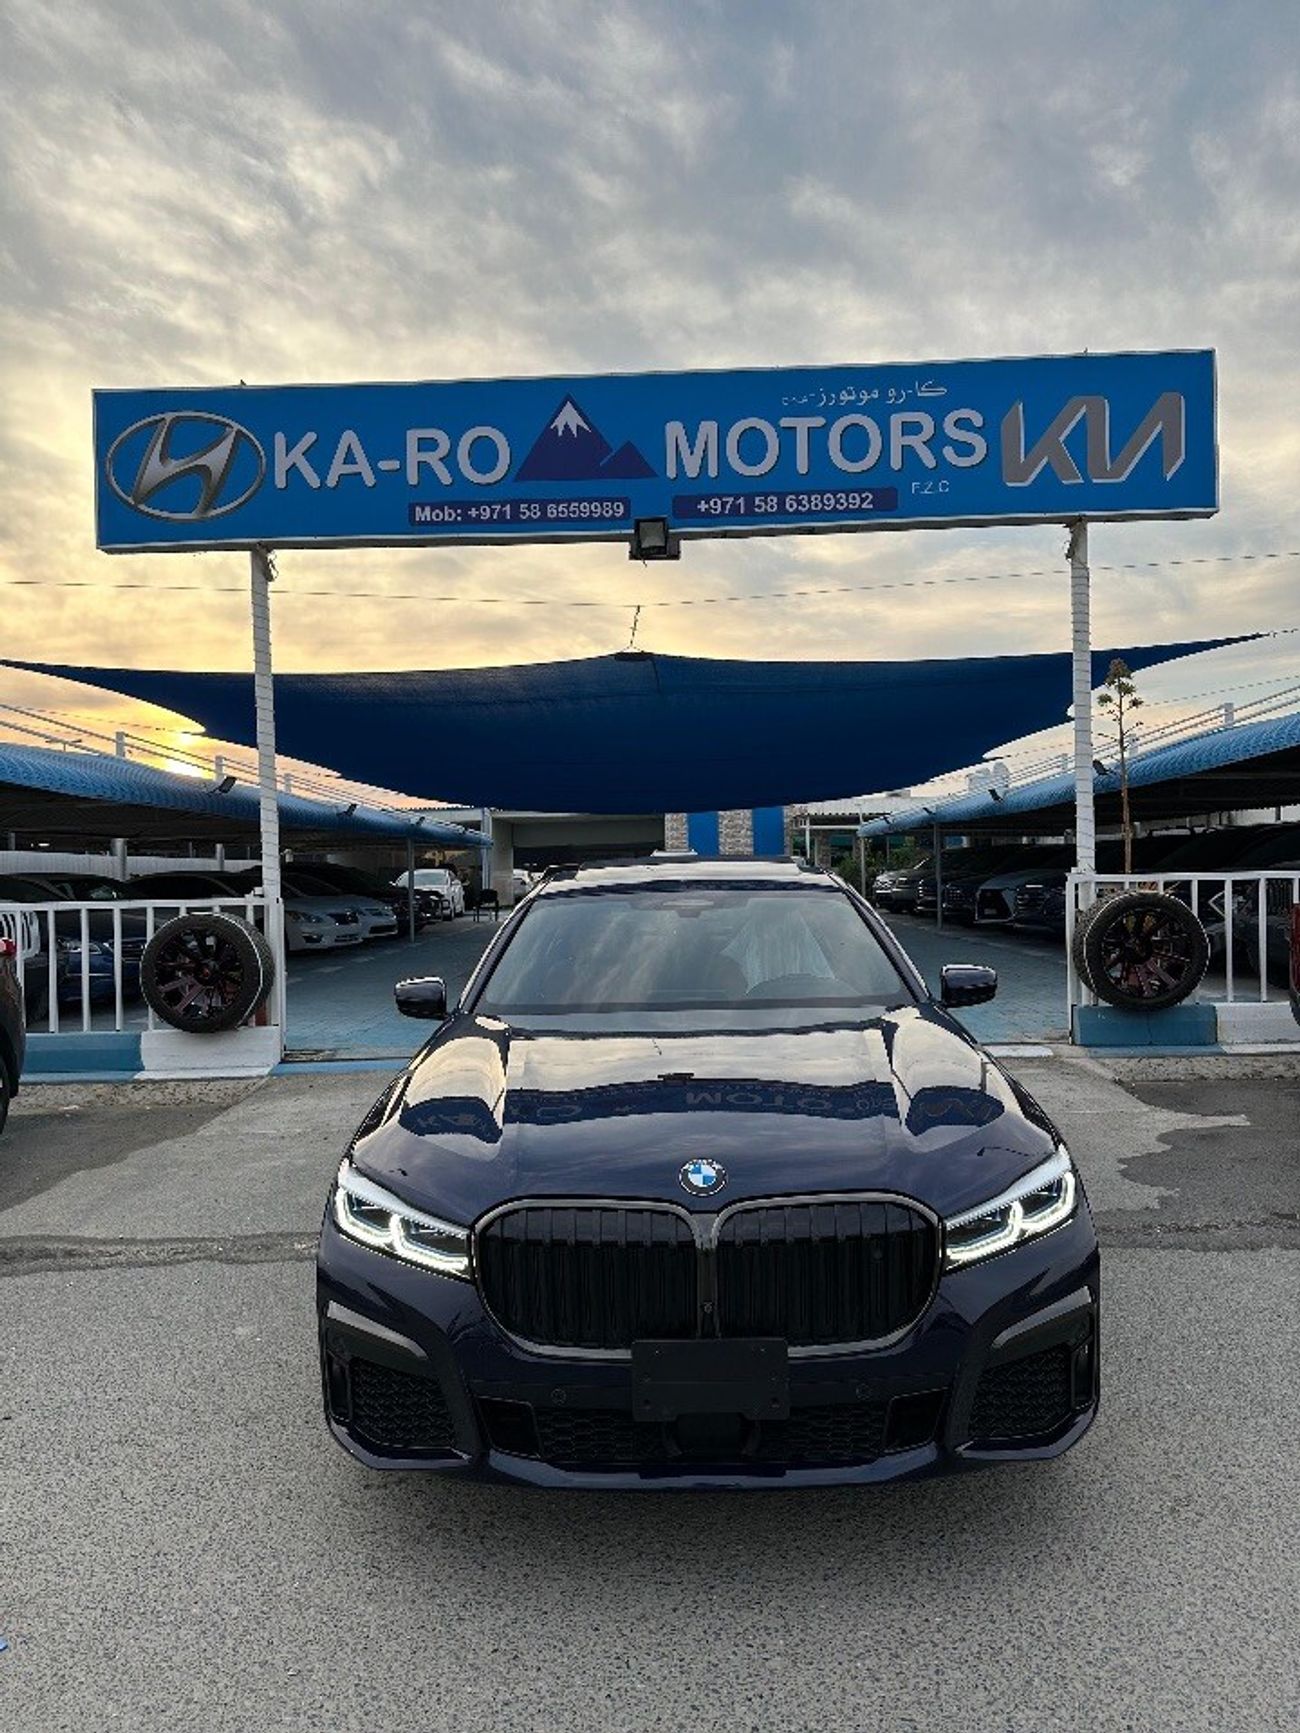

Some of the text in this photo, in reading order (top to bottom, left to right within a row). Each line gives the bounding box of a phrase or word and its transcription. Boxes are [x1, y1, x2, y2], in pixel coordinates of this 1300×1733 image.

[274, 408, 988, 489] KA-RO MOTORS
[415, 501, 624, 522] Mob: +971 58 6559989
[697, 492, 874, 514] +971 58 6389392
